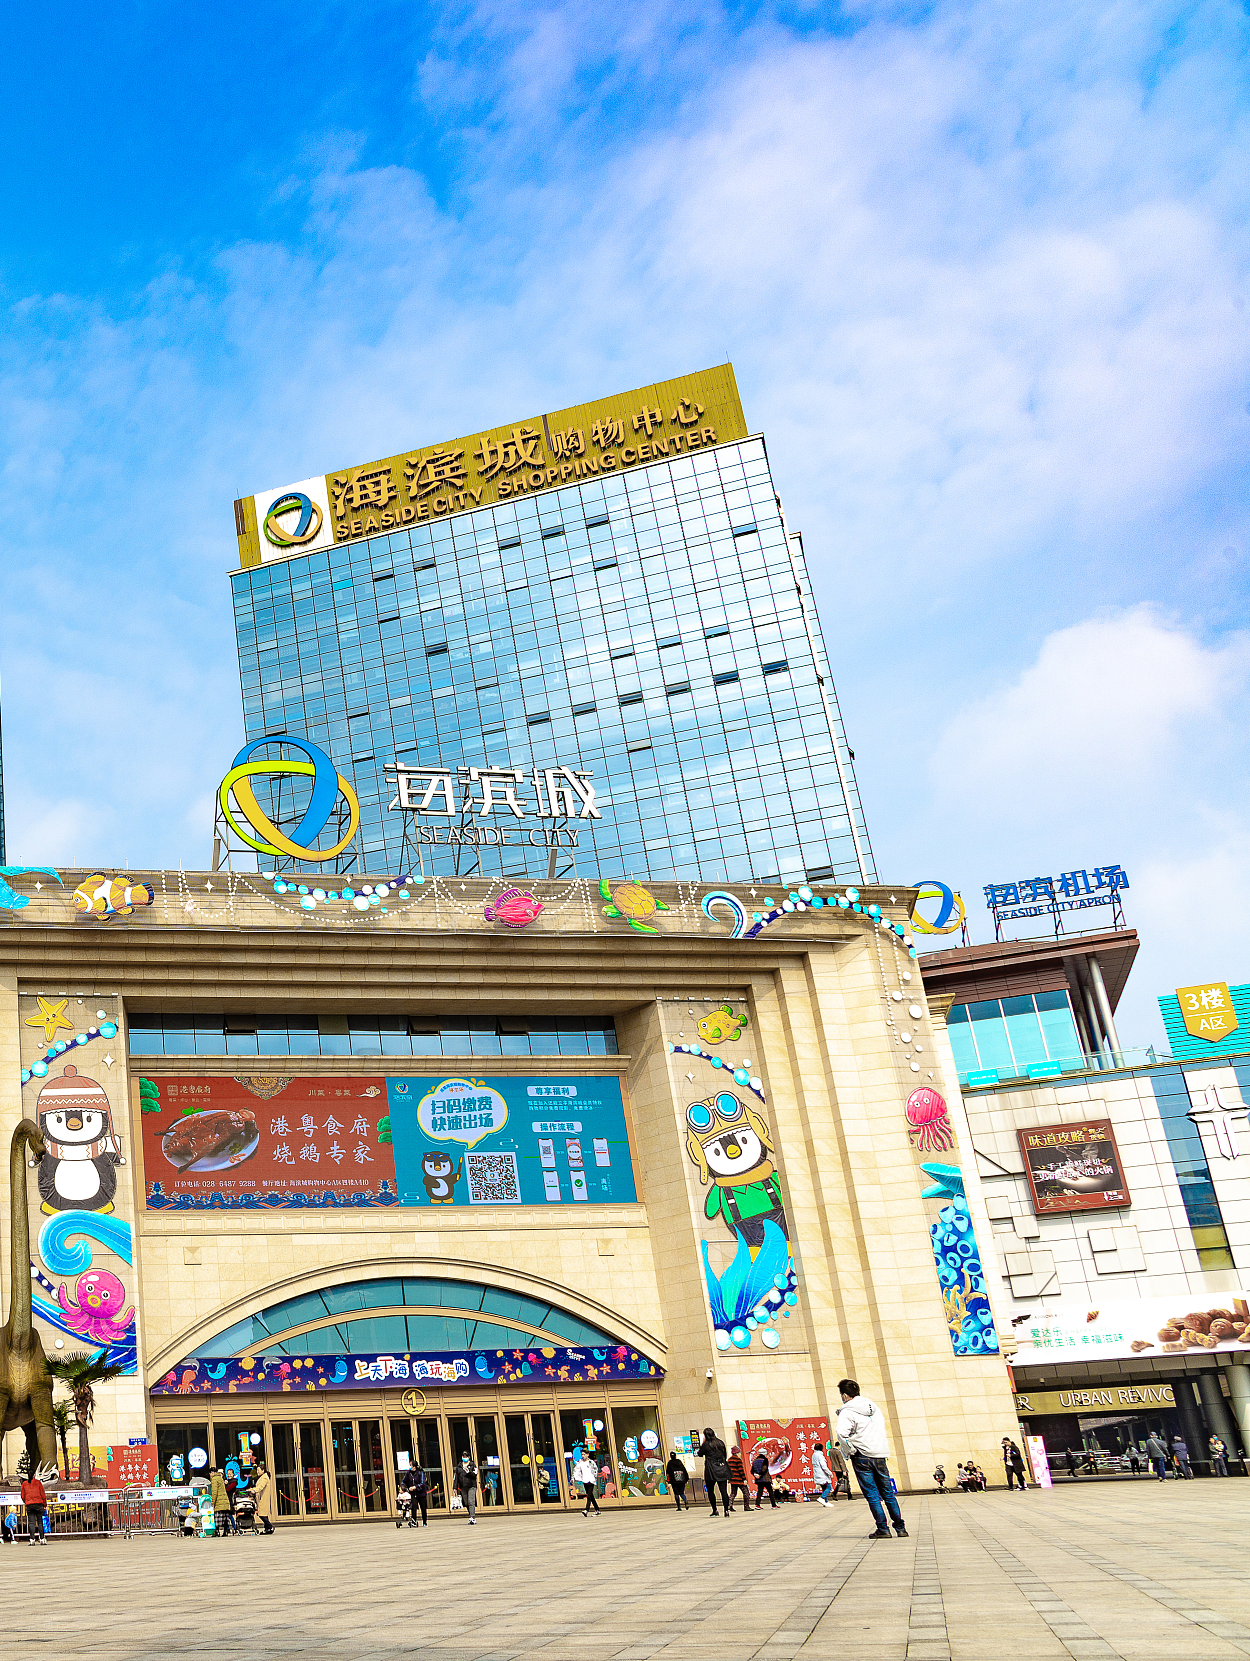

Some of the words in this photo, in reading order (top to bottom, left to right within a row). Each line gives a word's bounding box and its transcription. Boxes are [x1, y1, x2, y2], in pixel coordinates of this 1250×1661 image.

[331, 426, 545, 518] 海滨城
[551, 397, 706, 460] 购物中心
[336, 504, 430, 539] SEASIDE
[433, 486, 484, 517] CITY
[498, 452, 617, 497] SHOPPING
[620, 426, 718, 466] CENTER
[419, 825, 513, 846] SEASIDE
[529, 827, 581, 847] CITY
[996, 905, 1045, 922] SEASIDE
[1047, 900, 1077, 914] CITY
[1078, 893, 1122, 910] APRON
[1184, 988, 1225, 1011] 3楼
[1199, 1015, 1228, 1031] A区
[430, 1096, 493, 1116] 扫码缴费
[269, 1113, 371, 1138] 港粤食府
[431, 1113, 494, 1132] 快速出场
[1028, 1130, 1086, 1148] 味道攻略
[272, 1140, 375, 1165] 烧鹅专家
[355, 1356, 409, 1381] 上天下海
[412, 1358, 470, 1382] 海玩海购
[1059, 1390, 1113, 1408] URBAN
[796, 1430, 812, 1476] 港粤食府
